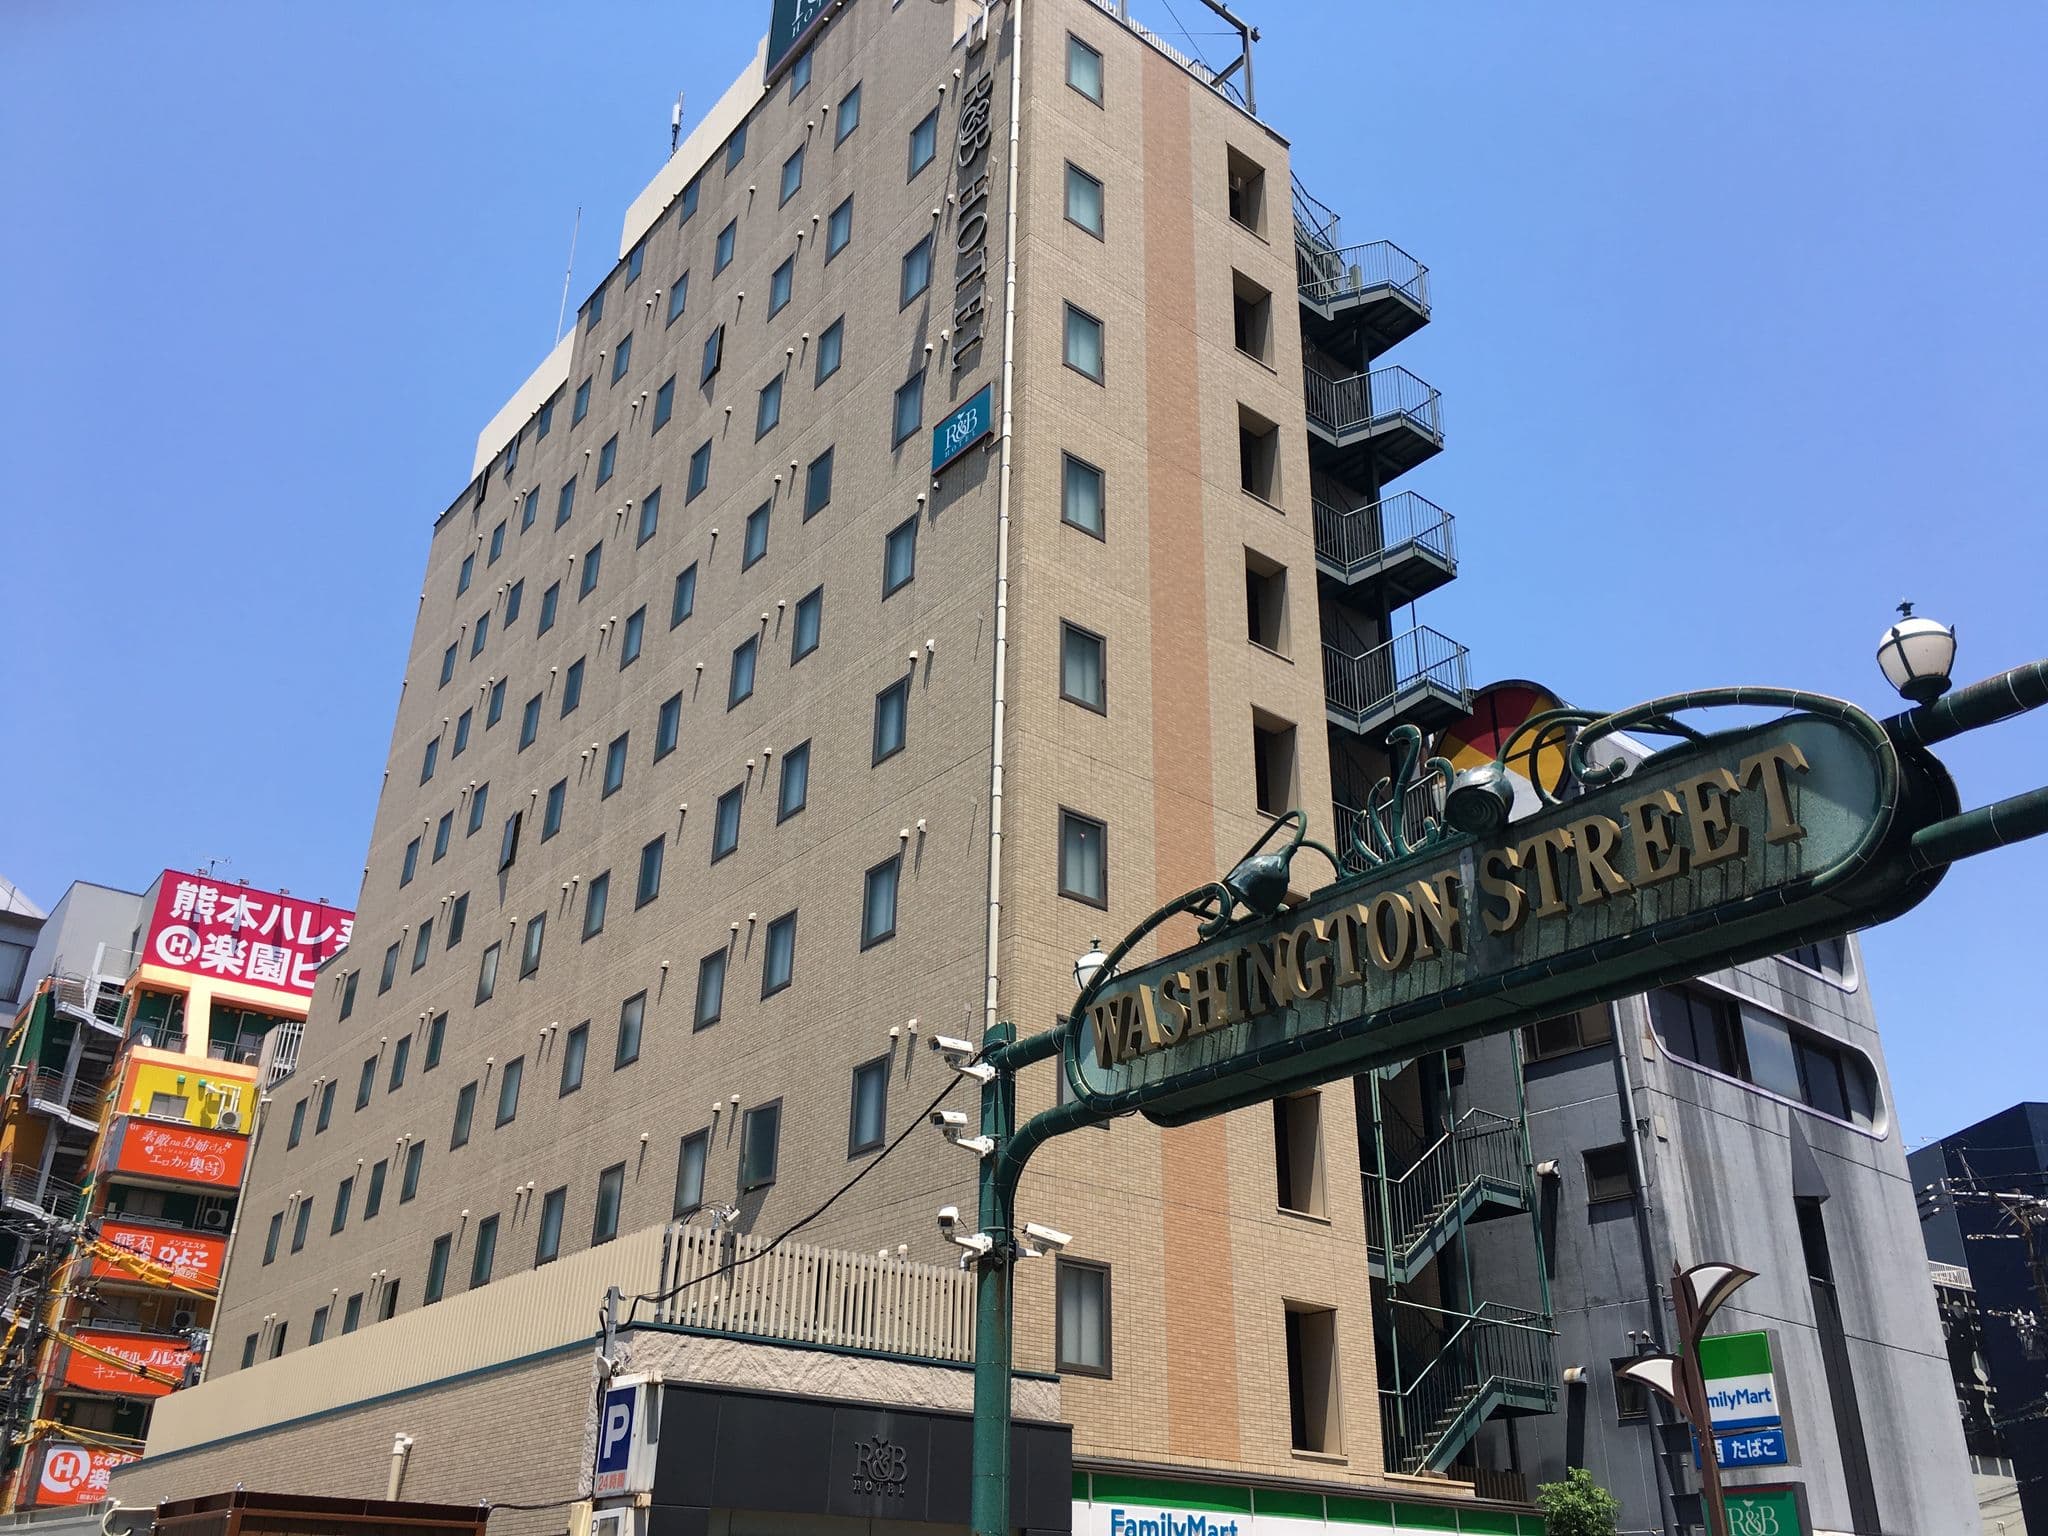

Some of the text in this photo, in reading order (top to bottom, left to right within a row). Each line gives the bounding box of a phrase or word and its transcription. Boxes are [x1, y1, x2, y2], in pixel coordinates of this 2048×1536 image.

[953, 68, 993, 371] R&B HOTEL
[945, 408, 977, 451] R&B
[1085, 743, 1810, 1070] WASHINGTON STREET
[159, 1246, 209, 1268] ひよこ
[1708, 1388, 1772, 1410] milyMart
[603, 1403, 630, 1459] P
[1731, 1436, 1778, 1460] たばこ
[853, 1441, 907, 1482] R&B
[853, 1479, 905, 1496] HOTEL
